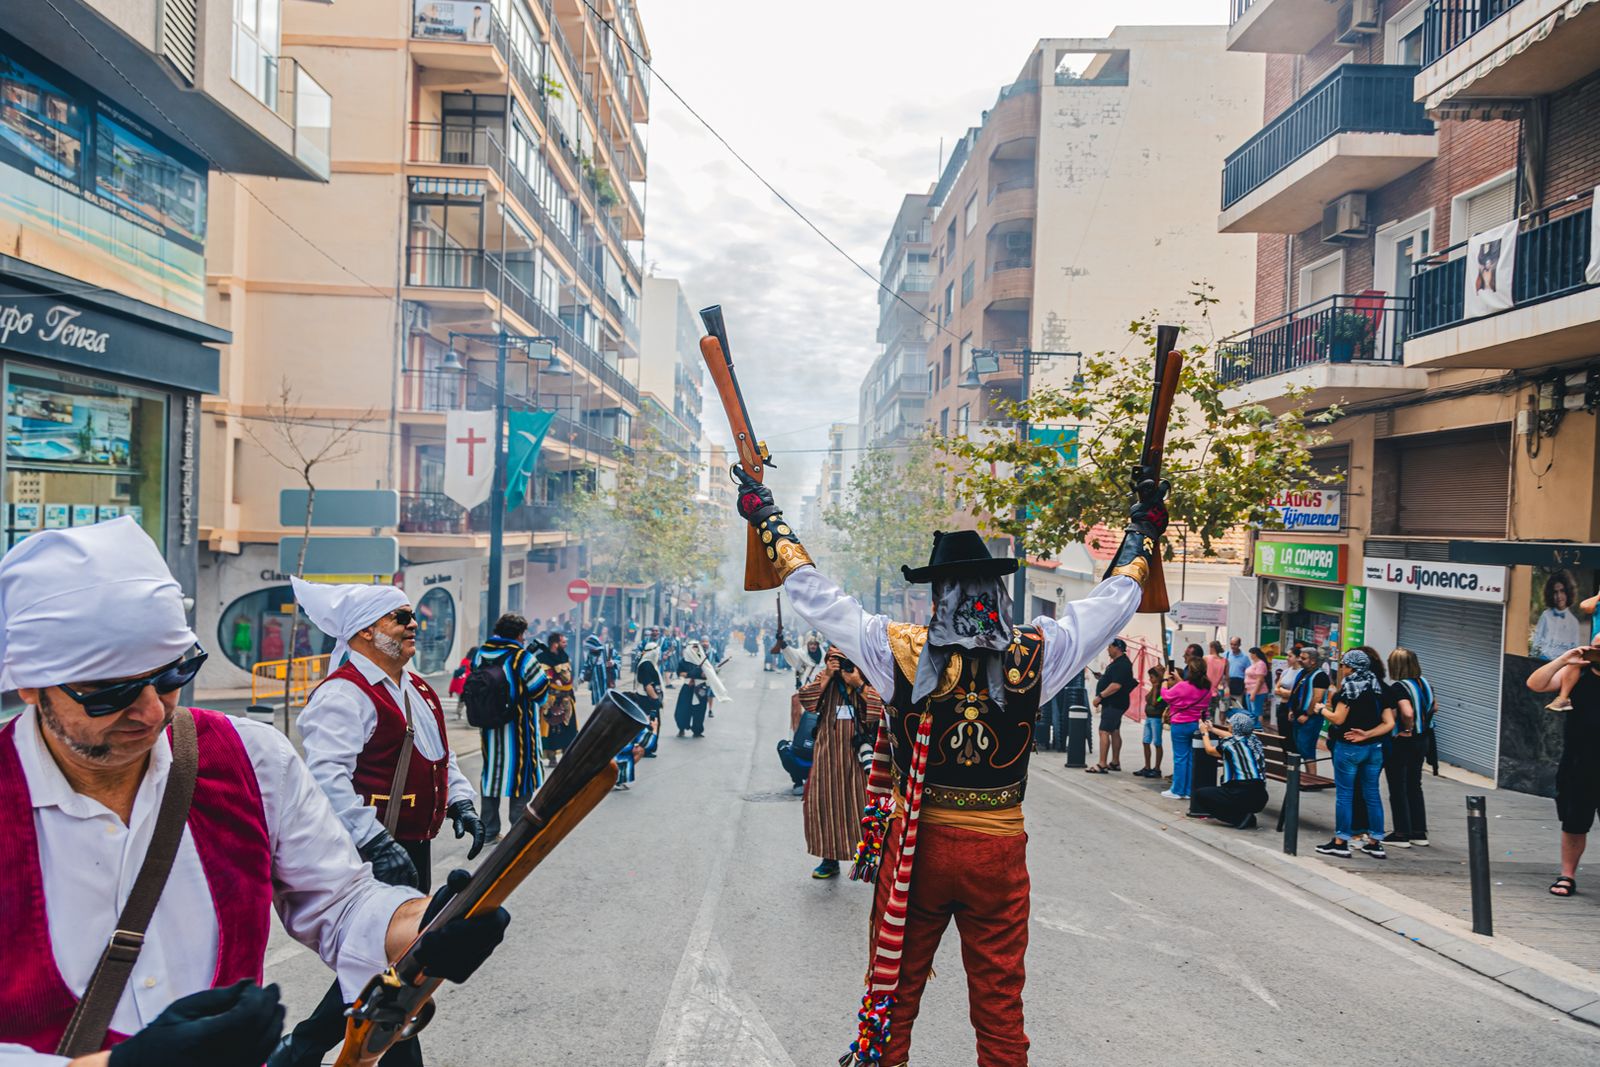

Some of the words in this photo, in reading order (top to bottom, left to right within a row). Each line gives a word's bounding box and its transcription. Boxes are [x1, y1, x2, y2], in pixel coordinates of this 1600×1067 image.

[38, 305, 110, 353] Tenza
[1280, 548, 1293, 565] LA
[1295, 549, 1334, 568] COMPRA
[1386, 563, 1403, 583] La
[1406, 565, 1478, 591] Jijonenca
